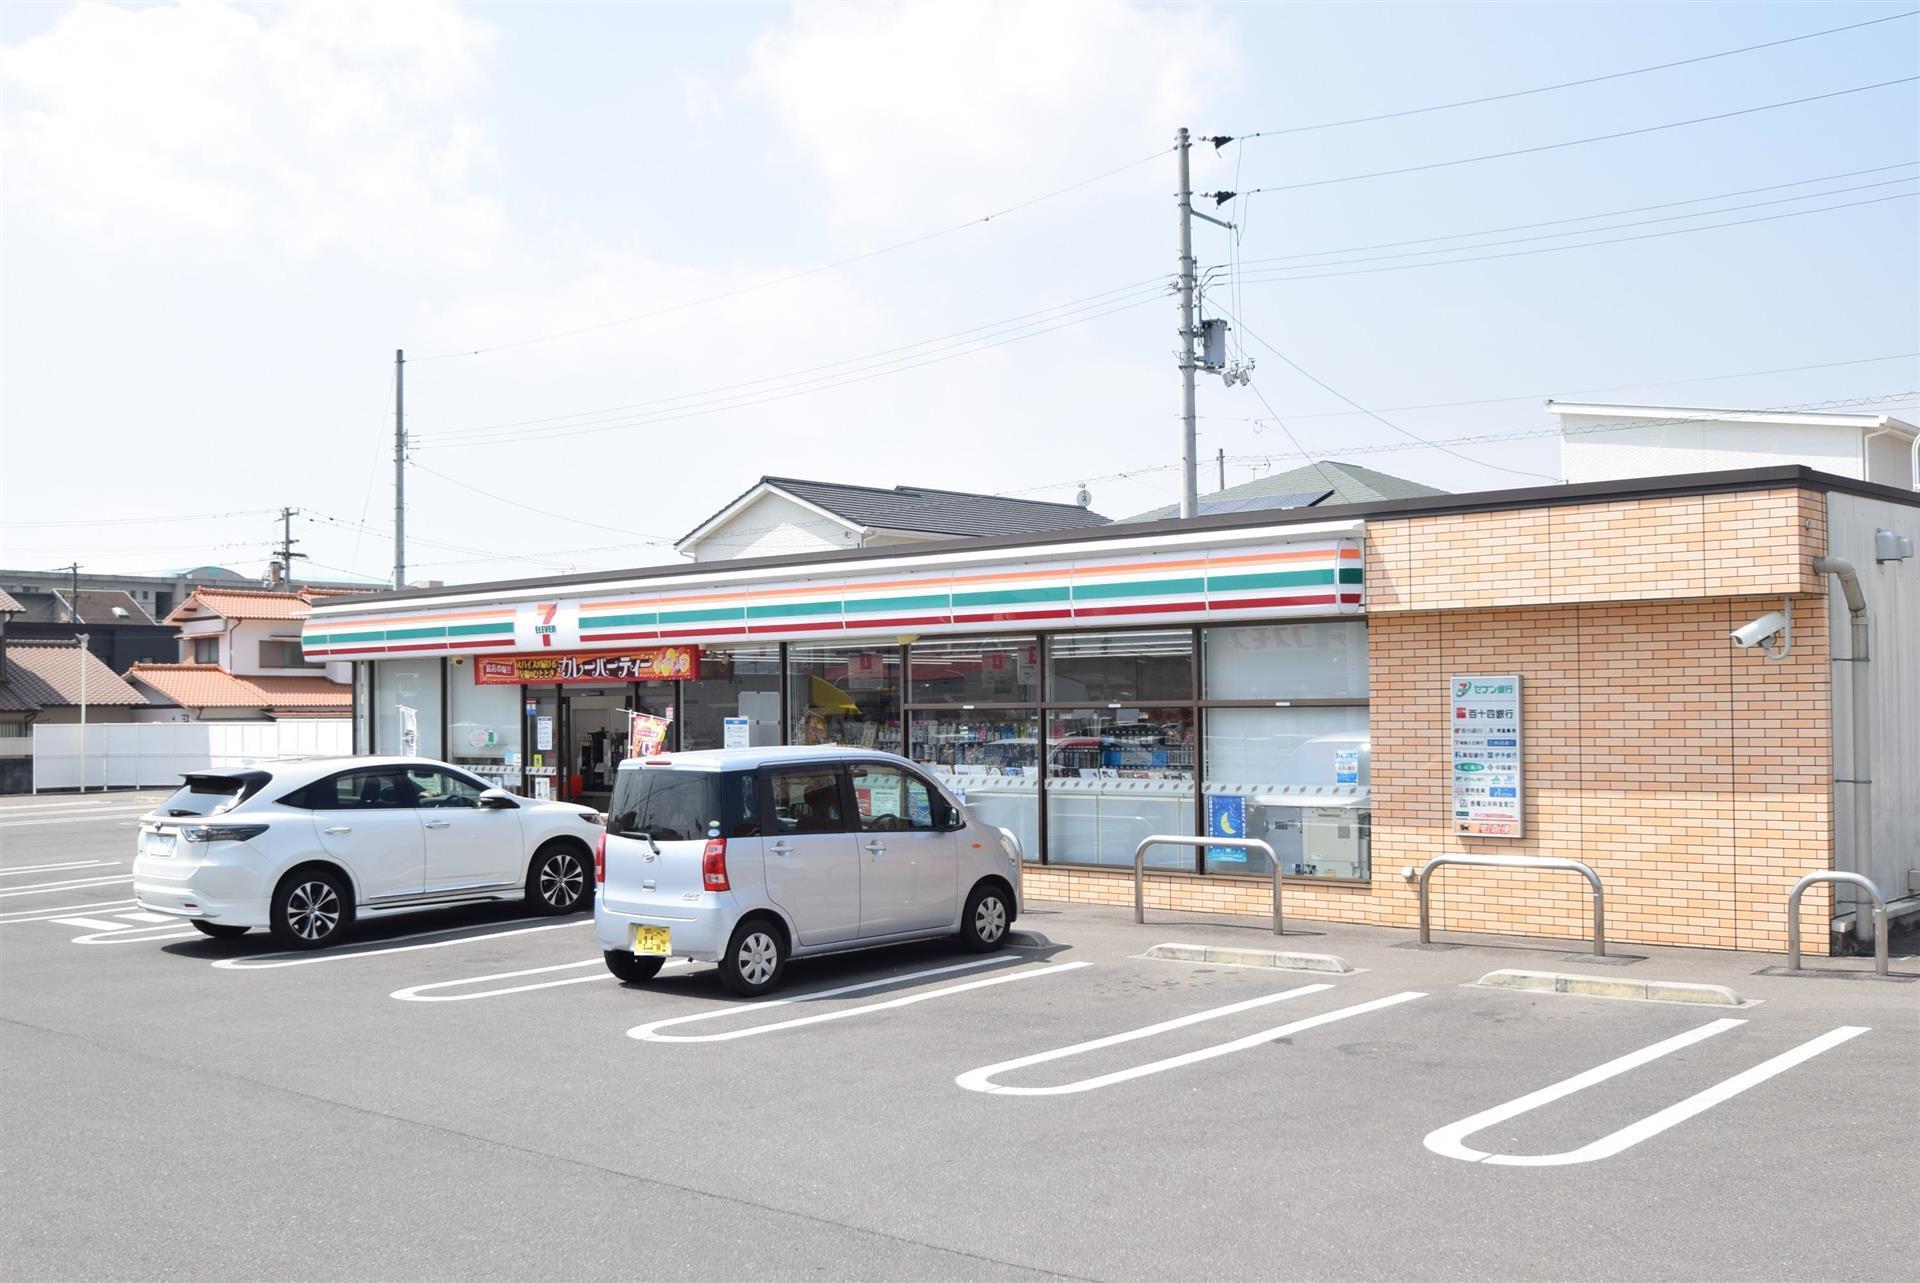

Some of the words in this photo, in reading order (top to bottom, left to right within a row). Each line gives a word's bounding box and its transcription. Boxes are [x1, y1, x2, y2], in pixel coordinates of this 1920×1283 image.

[1468, 709, 1514, 719] 百十四銀行
